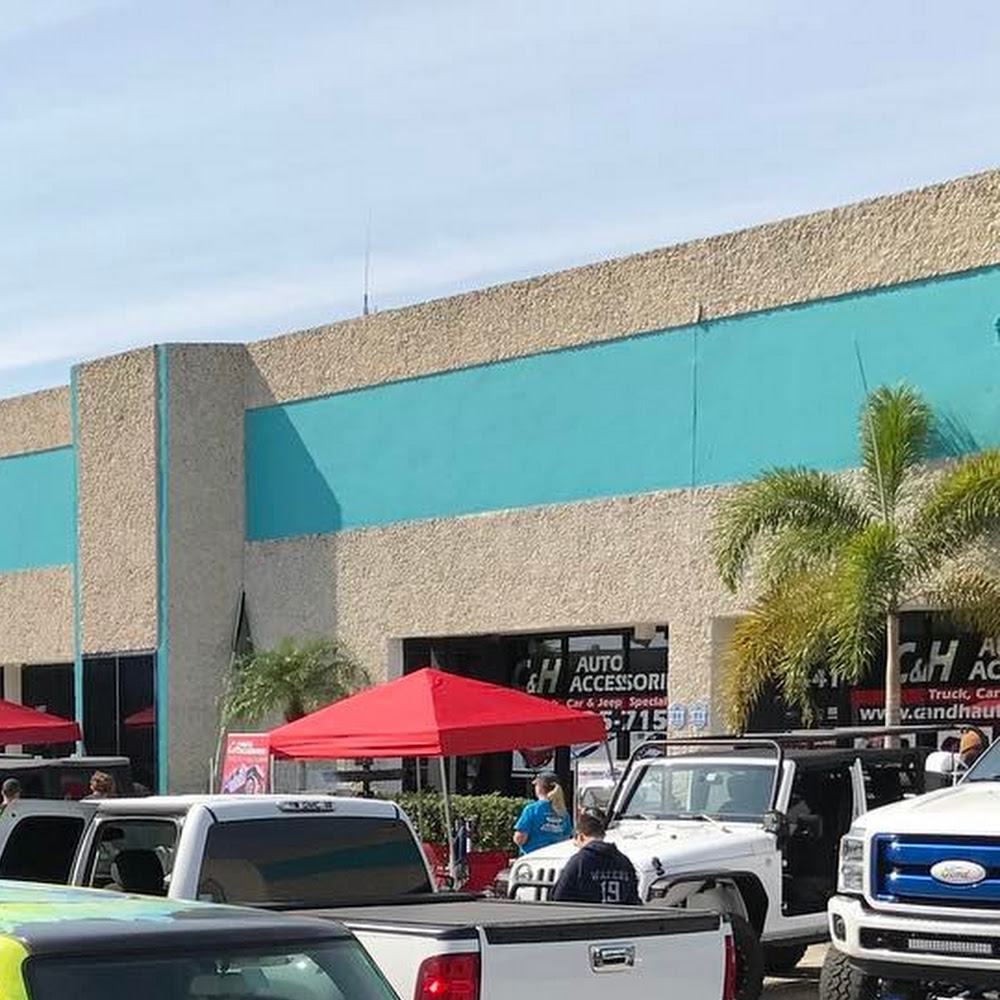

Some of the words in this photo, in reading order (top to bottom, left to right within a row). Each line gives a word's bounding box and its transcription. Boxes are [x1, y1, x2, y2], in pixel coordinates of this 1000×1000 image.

[576, 654, 623, 673] AUTO
[928, 688, 971, 701] Truck,
[566, 697, 583, 708] Car
[597, 697, 623, 709] Jeep
[600, 881, 620, 902] 19
